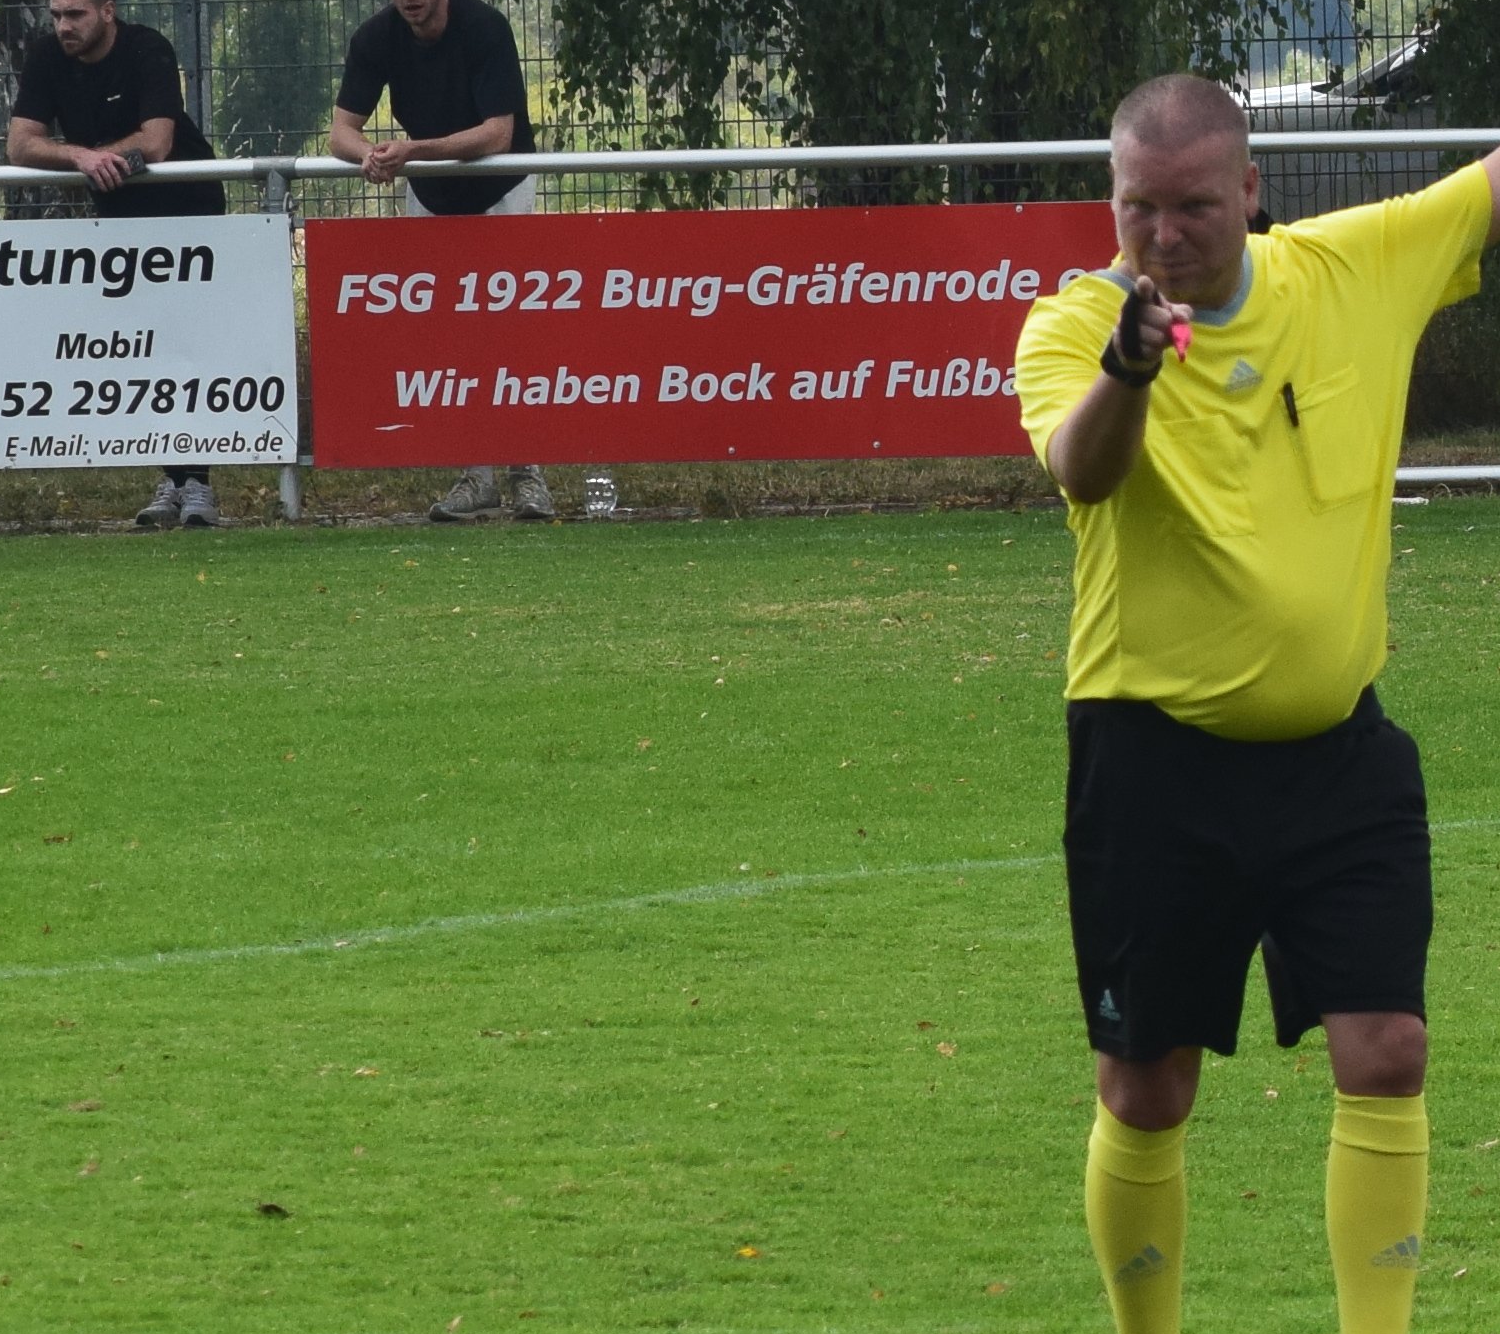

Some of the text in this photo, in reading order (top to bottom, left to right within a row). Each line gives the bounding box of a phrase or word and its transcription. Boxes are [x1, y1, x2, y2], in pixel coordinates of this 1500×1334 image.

[336, 273, 437, 315] FSG
[454, 269, 583, 312] 1922
[601, 259, 1040, 317] Burg-Gräfenrode
[55, 330, 153, 361] Mobil
[67, 376, 286, 417] 29781600
[394, 369, 481, 408] Wir
[495, 365, 640, 405] haben
[657, 364, 773, 402] Bock
[788, 359, 875, 399] auf
[5, 434, 89, 458] E-Mail:
[98, 432, 283, 456] vardi1@web.de
